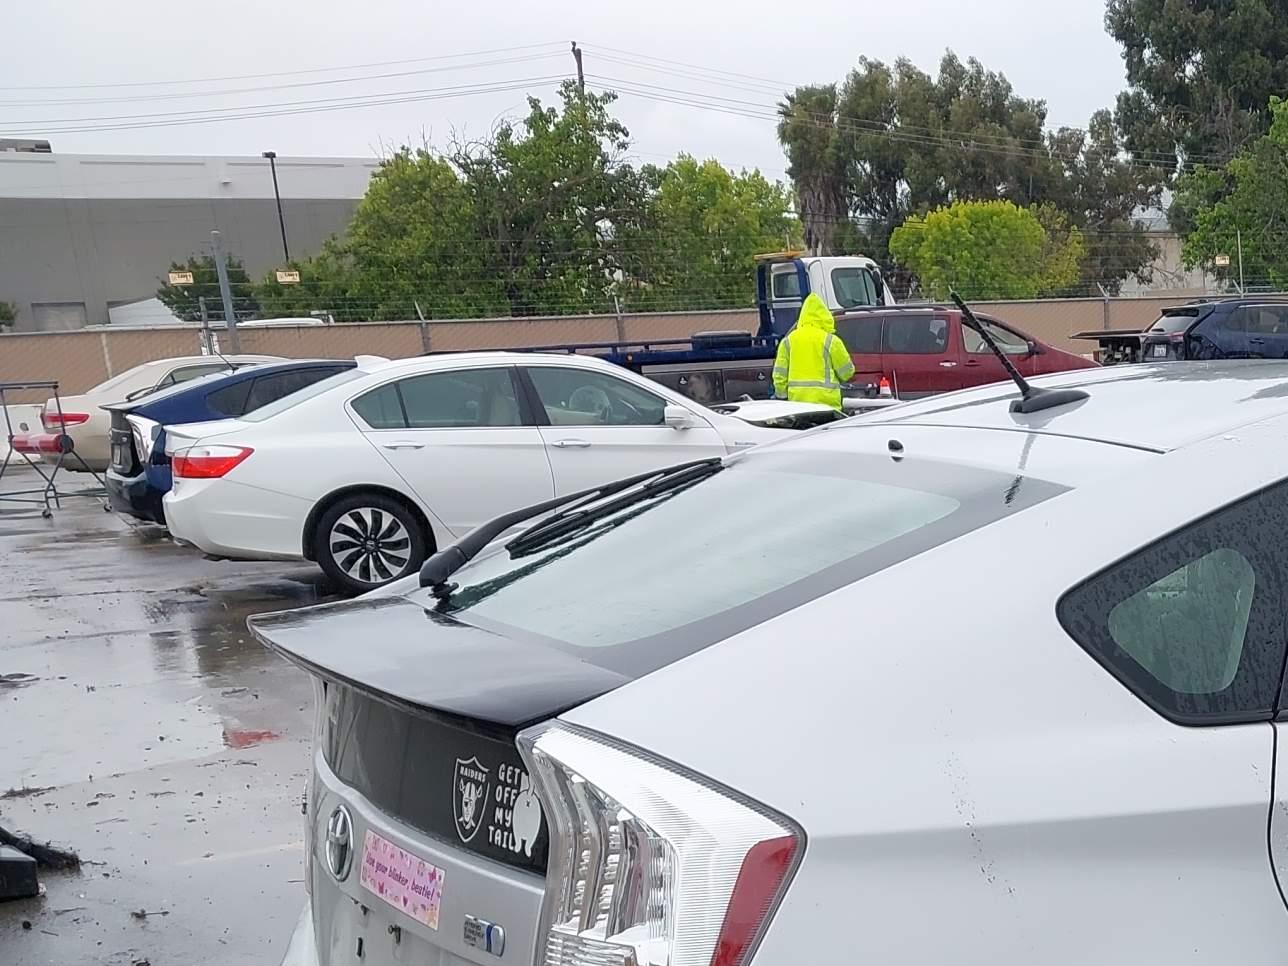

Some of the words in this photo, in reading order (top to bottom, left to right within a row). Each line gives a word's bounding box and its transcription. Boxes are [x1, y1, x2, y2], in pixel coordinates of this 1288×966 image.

[460, 765, 486, 783] RAIDERS
[498, 763, 521, 786] GET
[495, 785, 518, 807] OFF
[494, 807, 513, 828] MY
[488, 825, 515, 851] TAIL
[411, 878, 436, 901] bestie!
